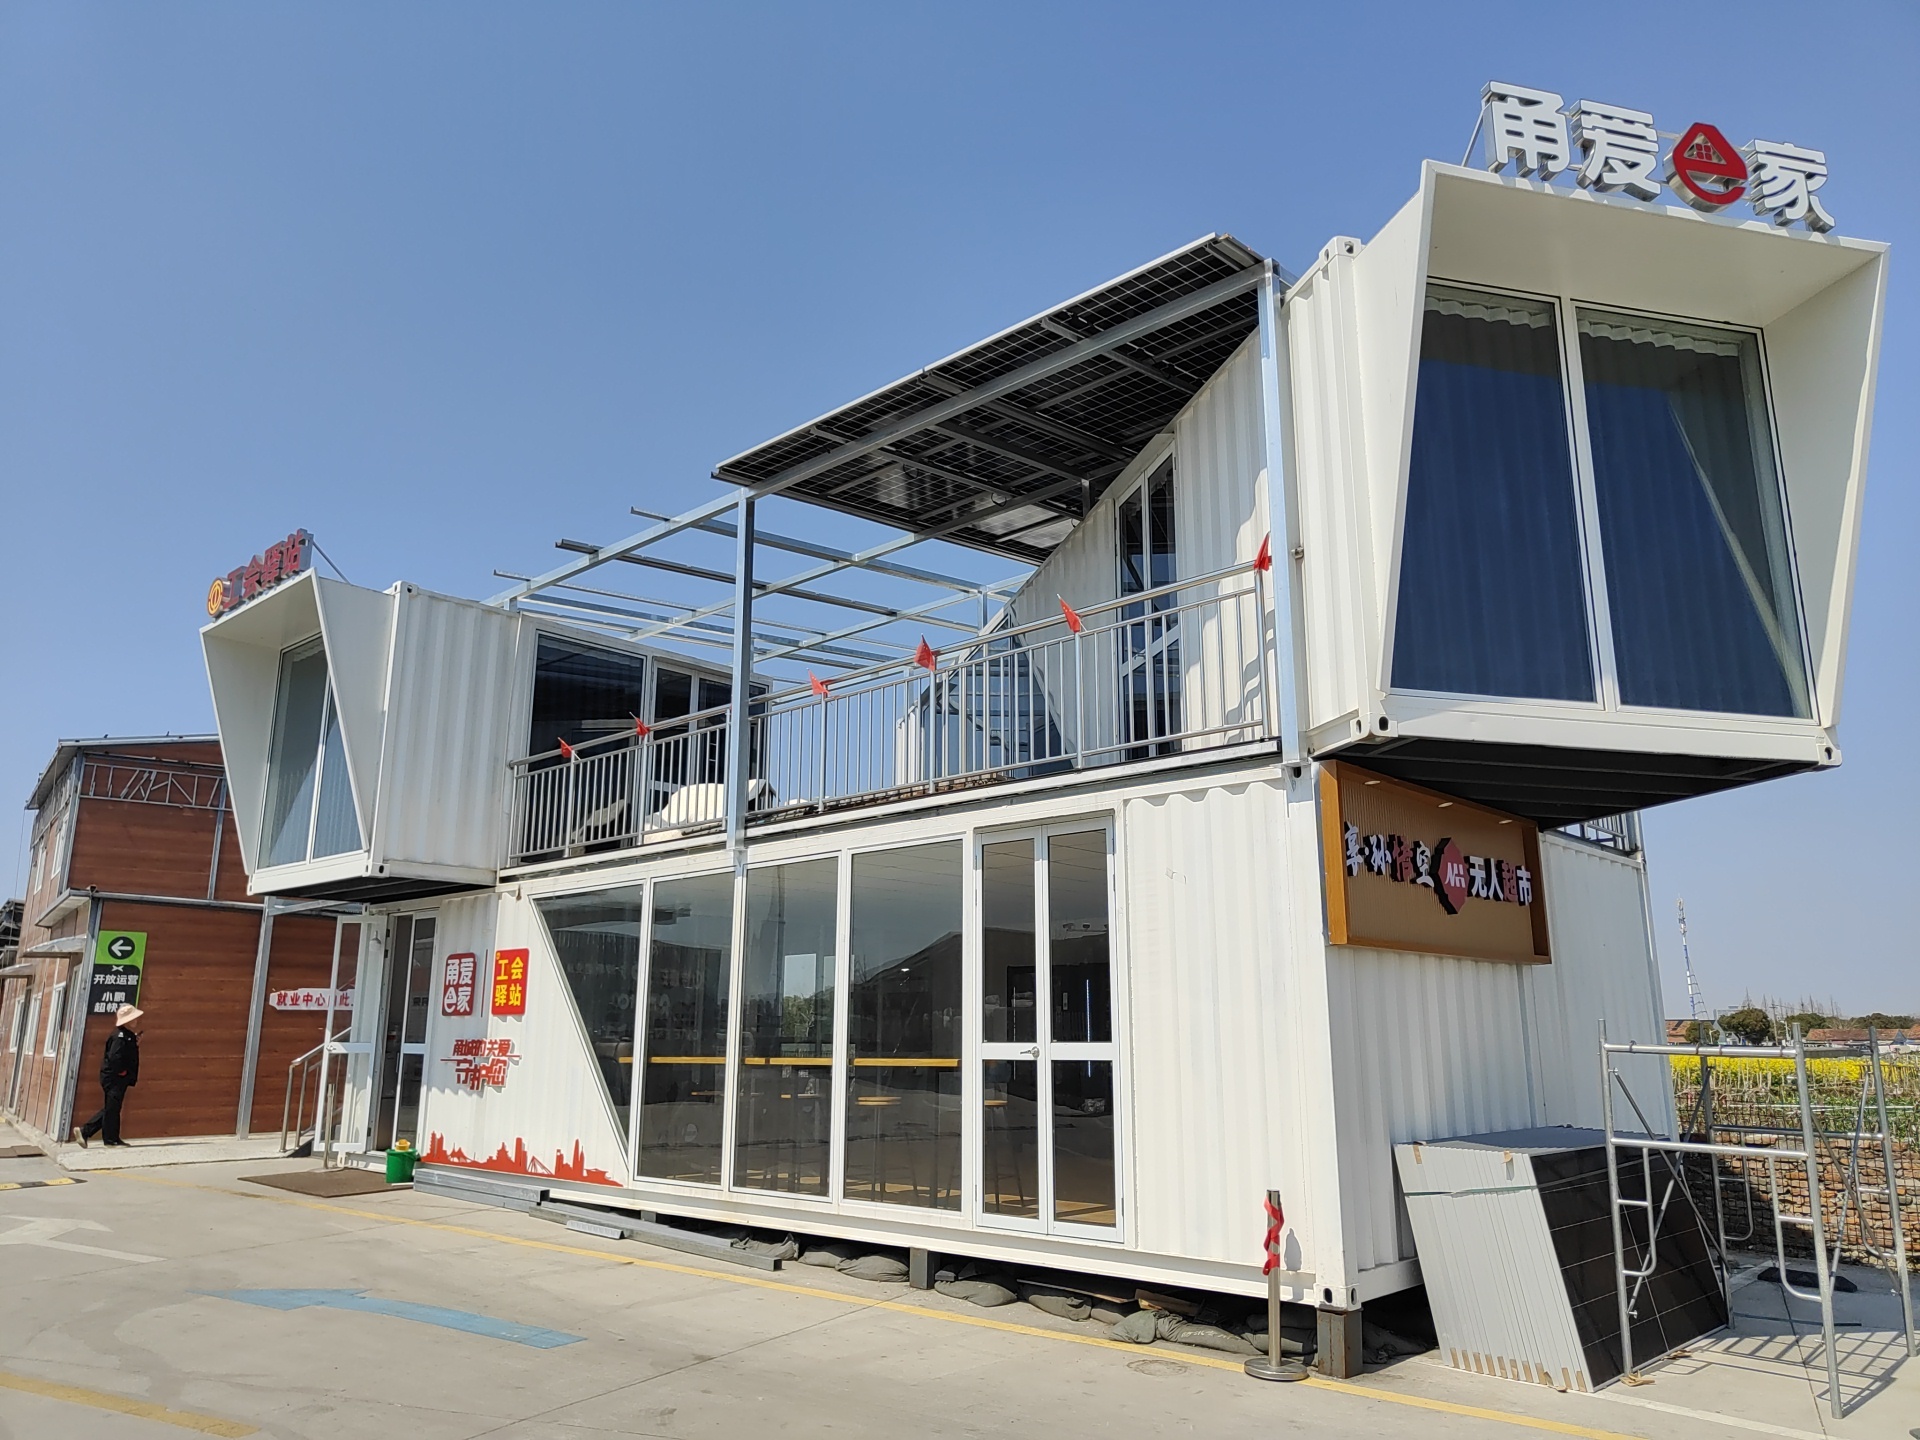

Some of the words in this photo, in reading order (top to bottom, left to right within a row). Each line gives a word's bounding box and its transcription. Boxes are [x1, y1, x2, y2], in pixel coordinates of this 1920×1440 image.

[1466, 856, 1533, 906] 无人超市
[445, 958, 474, 986] 甬爱
[496, 956, 524, 981] 工会
[93, 974, 139, 985] 开放运营
[101, 991, 126, 1002] 小鹏
[276, 992, 355, 1007] 就业中心此
[494, 983, 523, 1007] 驿站
[93, 1002, 130, 1013] 超快
